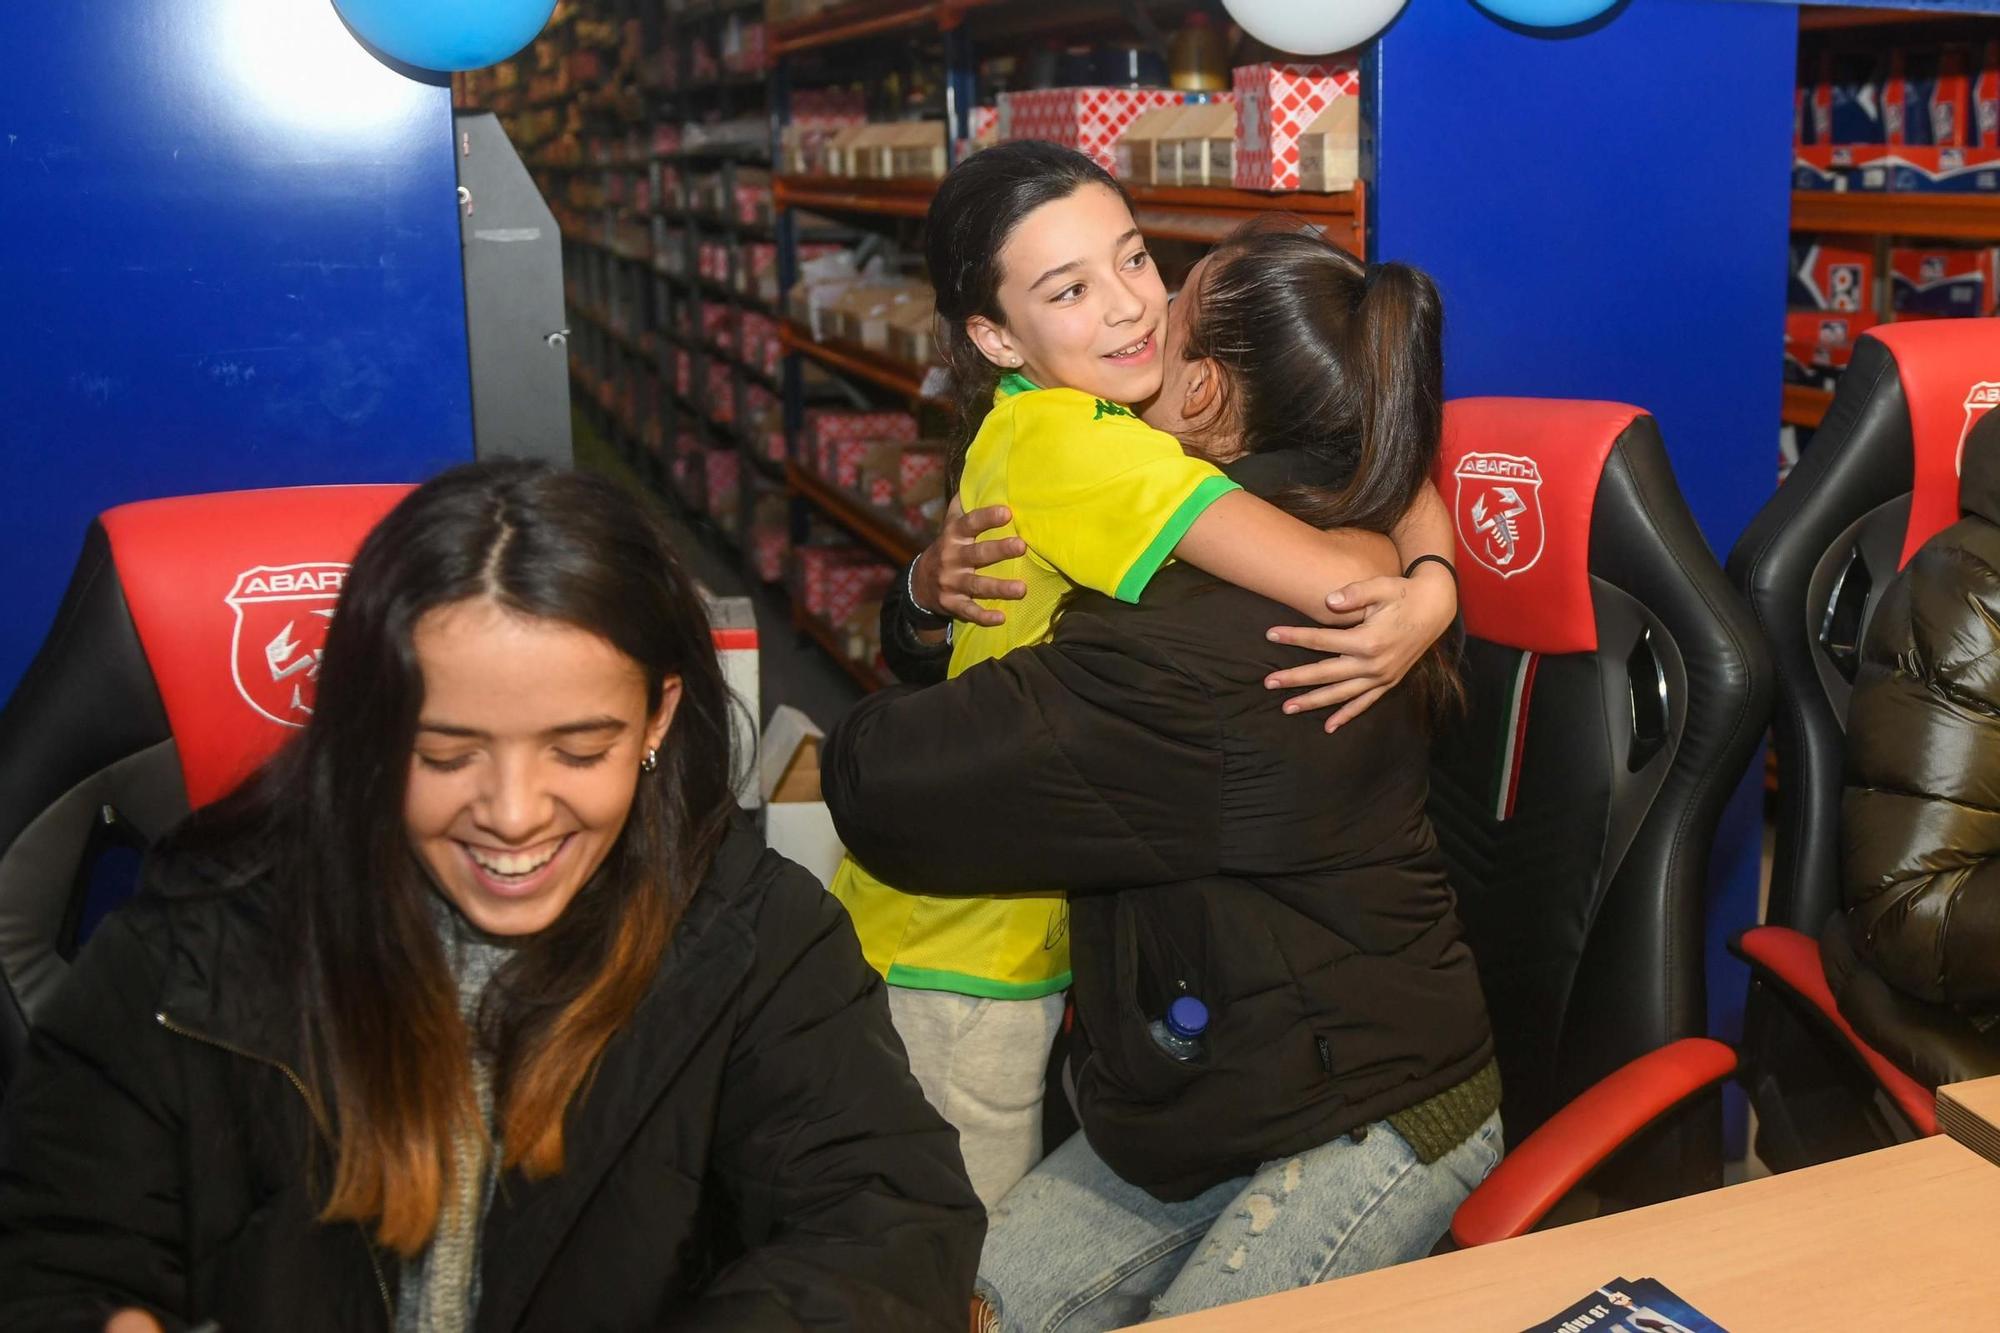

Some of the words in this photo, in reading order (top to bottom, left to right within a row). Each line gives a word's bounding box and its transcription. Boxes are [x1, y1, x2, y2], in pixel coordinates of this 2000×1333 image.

[1973, 387, 2000, 403] AB
[1462, 459, 1534, 478] ABARTH
[243, 571, 347, 595] ABAR
[1553, 1314, 1597, 1333] RAQU
